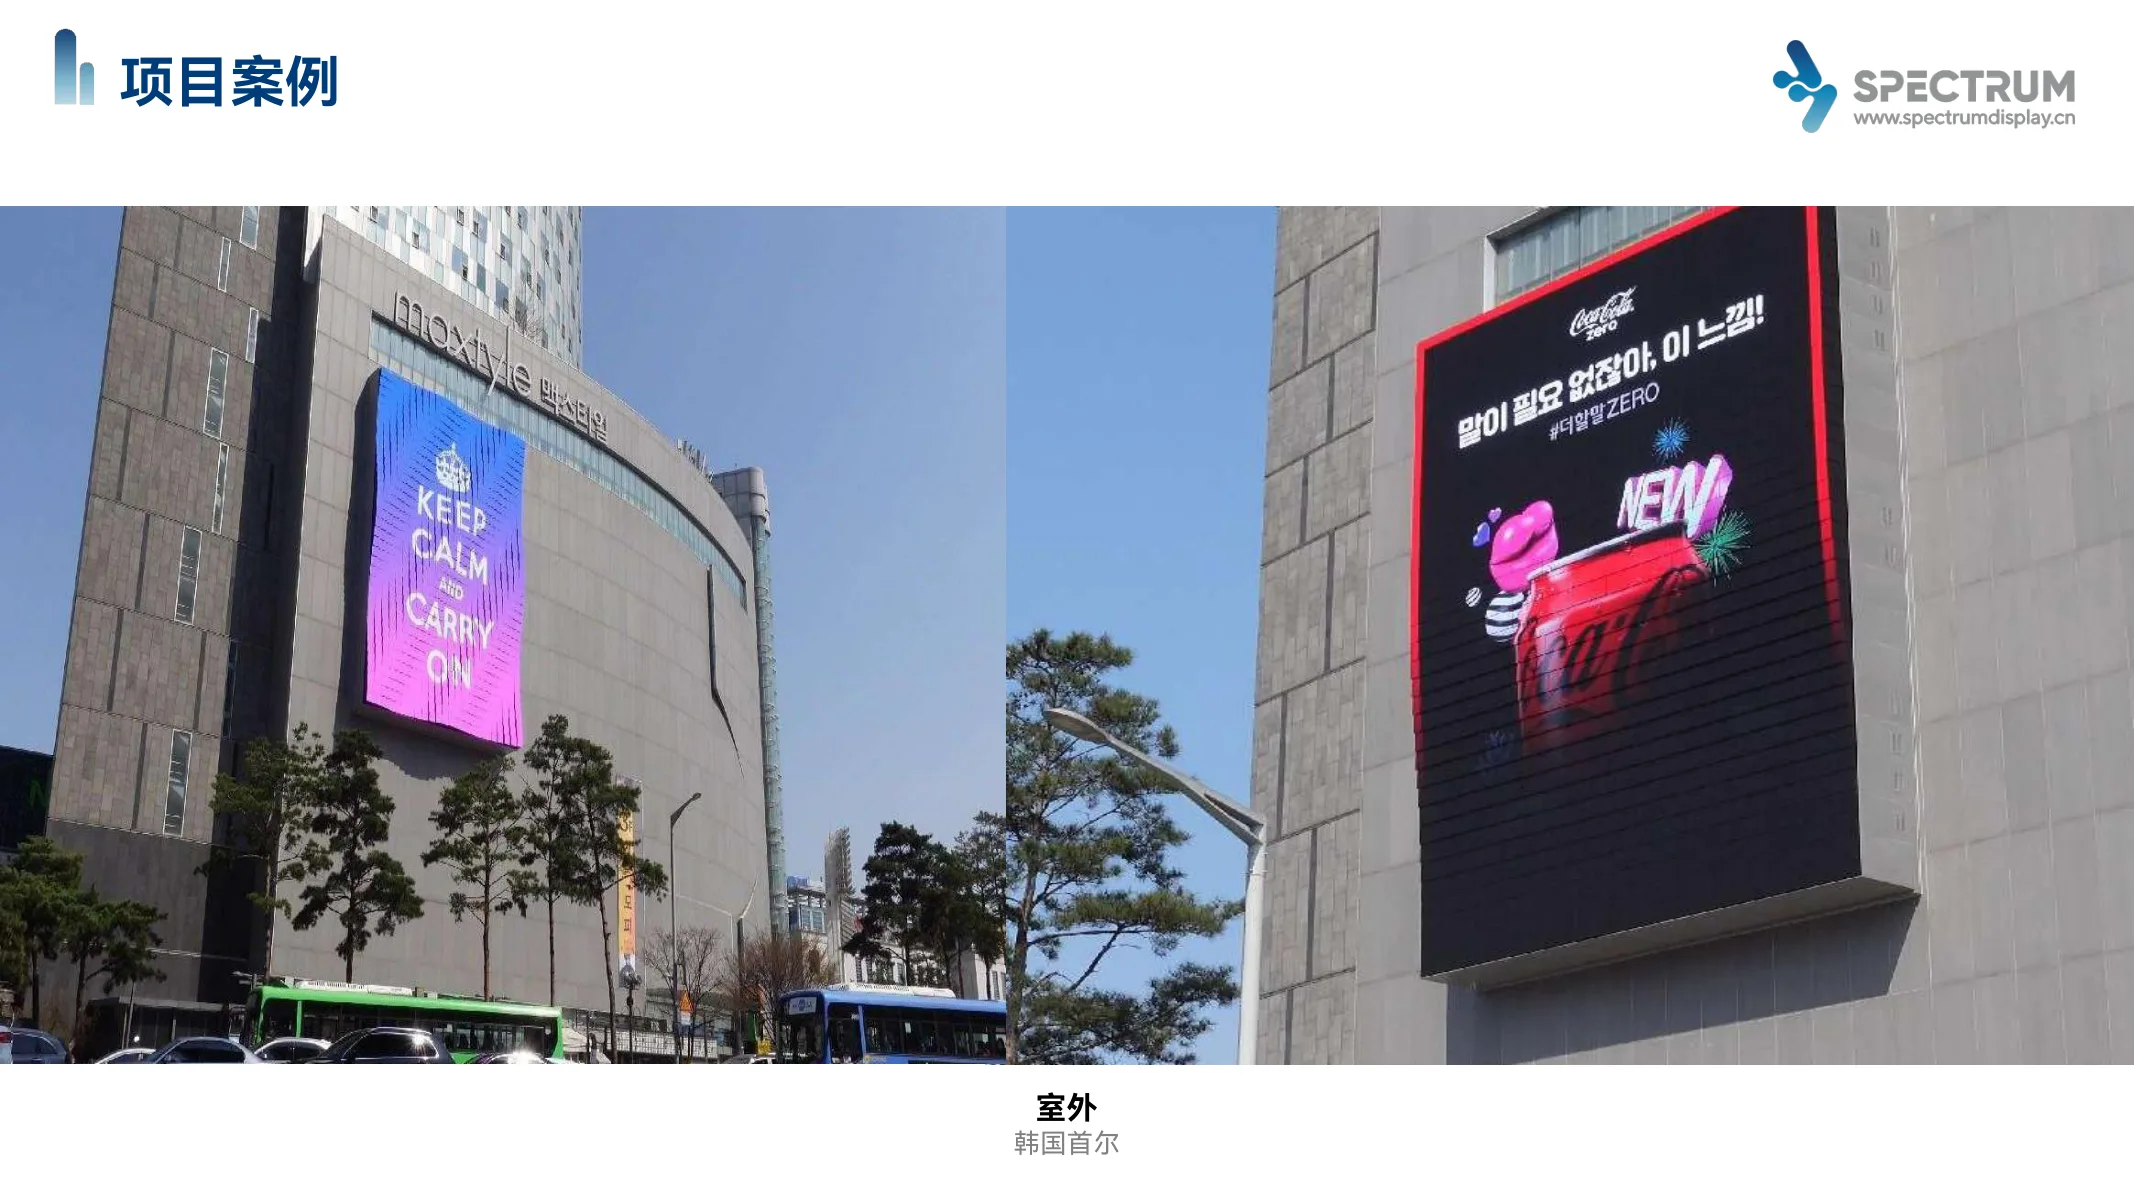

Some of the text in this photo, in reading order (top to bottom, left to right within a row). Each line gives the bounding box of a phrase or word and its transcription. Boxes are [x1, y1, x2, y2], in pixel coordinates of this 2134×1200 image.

[393, 290, 608, 445] maxtyle 맥스타일
[1458, 294, 1764, 449] 말이 필요 없잖아, 이 느낌!
[416, 484, 488, 537] KEEP
[1616, 454, 1733, 540] NEW
[411, 528, 489, 585] CALM
[439, 576, 465, 600] AND
[405, 592, 495, 650] CARRY
[426, 648, 473, 690] ON
